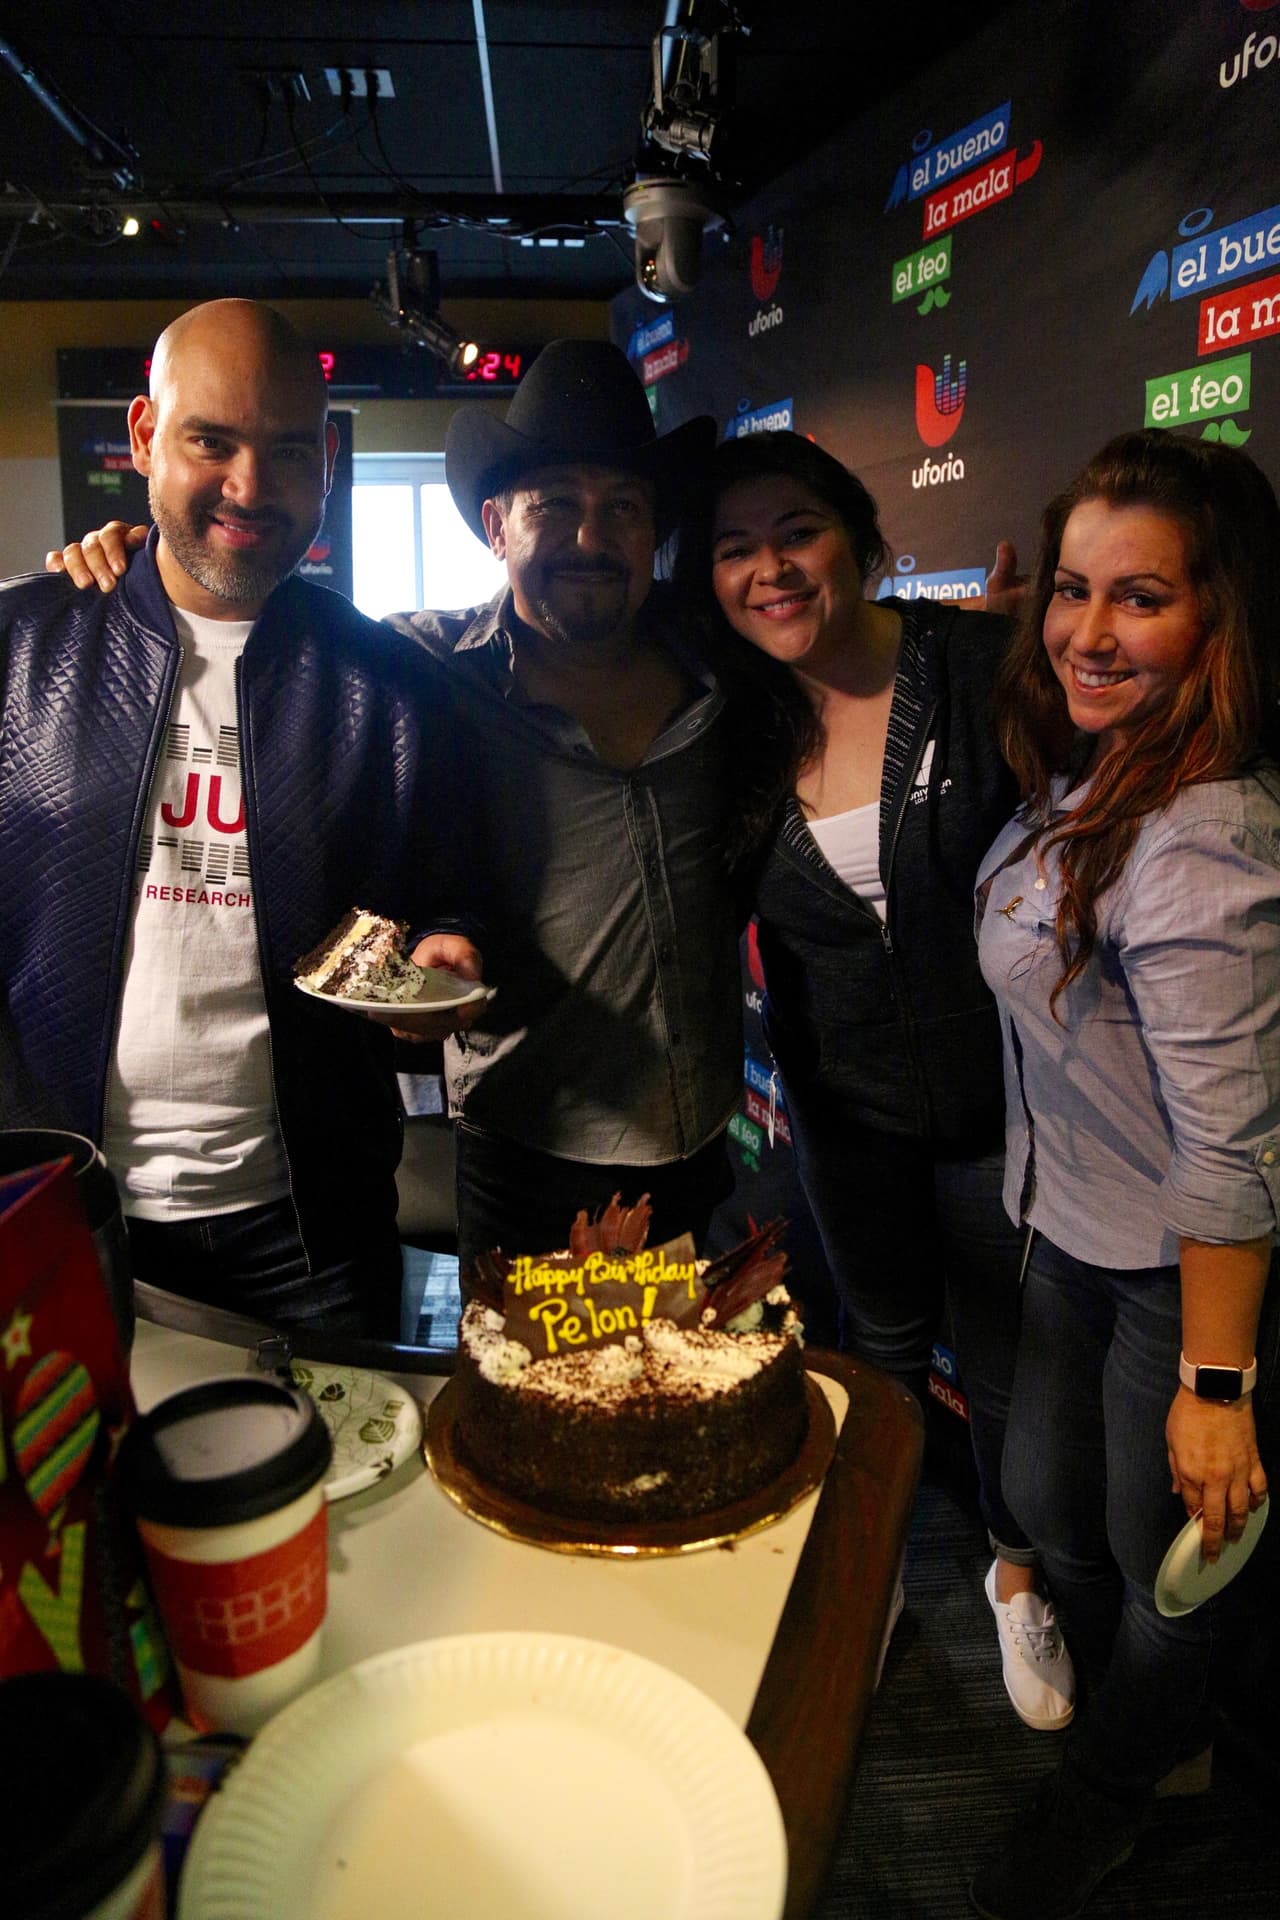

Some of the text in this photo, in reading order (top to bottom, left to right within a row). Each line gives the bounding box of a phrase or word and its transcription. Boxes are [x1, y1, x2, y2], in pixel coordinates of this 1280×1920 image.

[1220, 31, 1280, 88] ufo
[912, 121, 1005, 191] el bueno
[926, 165, 1010, 231] la mala
[895, 251, 947, 294] el feo
[1177, 245, 1207, 288] el
[749, 303, 783, 337] uforia
[1205, 306, 1240, 345] la
[1152, 374, 1243, 421] el feo
[912, 452, 965, 489] uforia
[146, 885, 250, 908] RESEARCH
[507, 1250, 697, 1300] Happy Birthday
